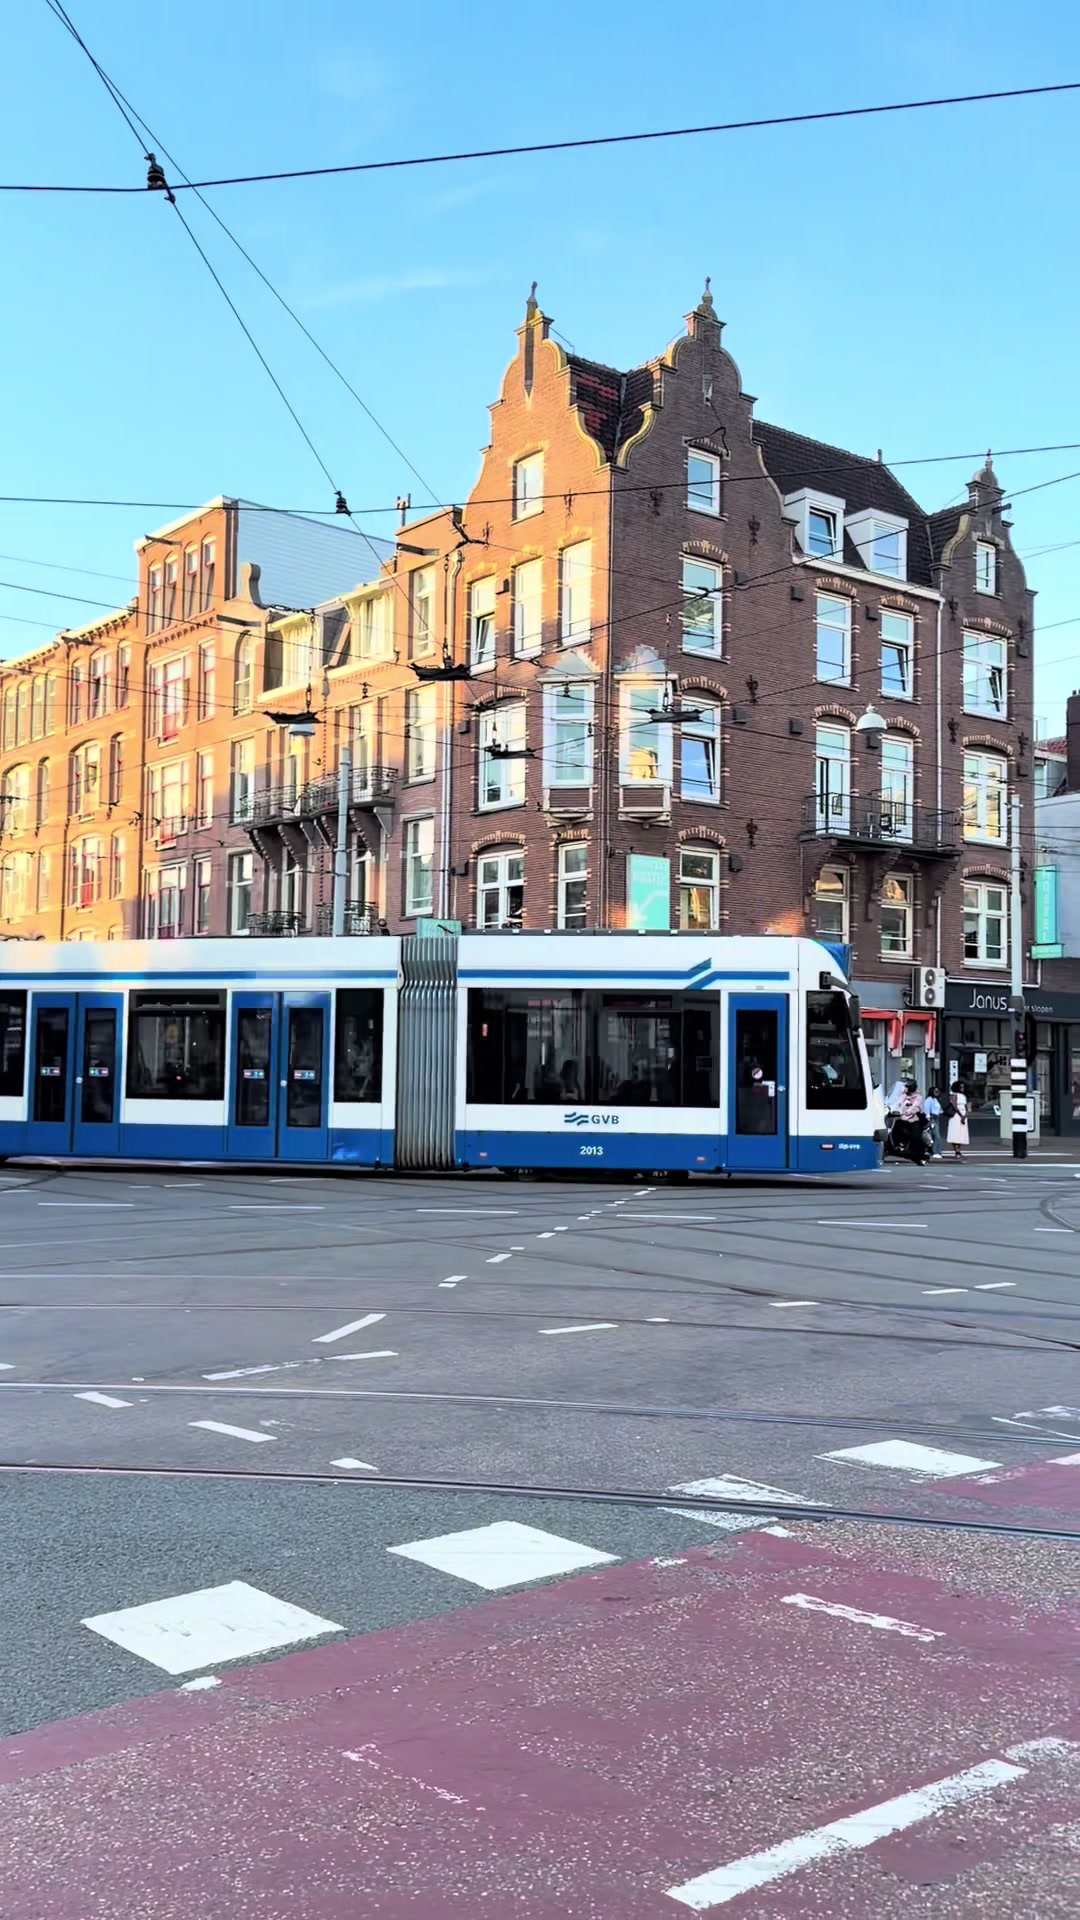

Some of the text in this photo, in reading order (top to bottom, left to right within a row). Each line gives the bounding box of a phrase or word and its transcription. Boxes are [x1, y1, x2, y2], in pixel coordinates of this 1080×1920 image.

[969, 988, 1007, 1010] Janus
[591, 1114, 620, 1125] GVB
[580, 1146, 603, 1155] 2013
